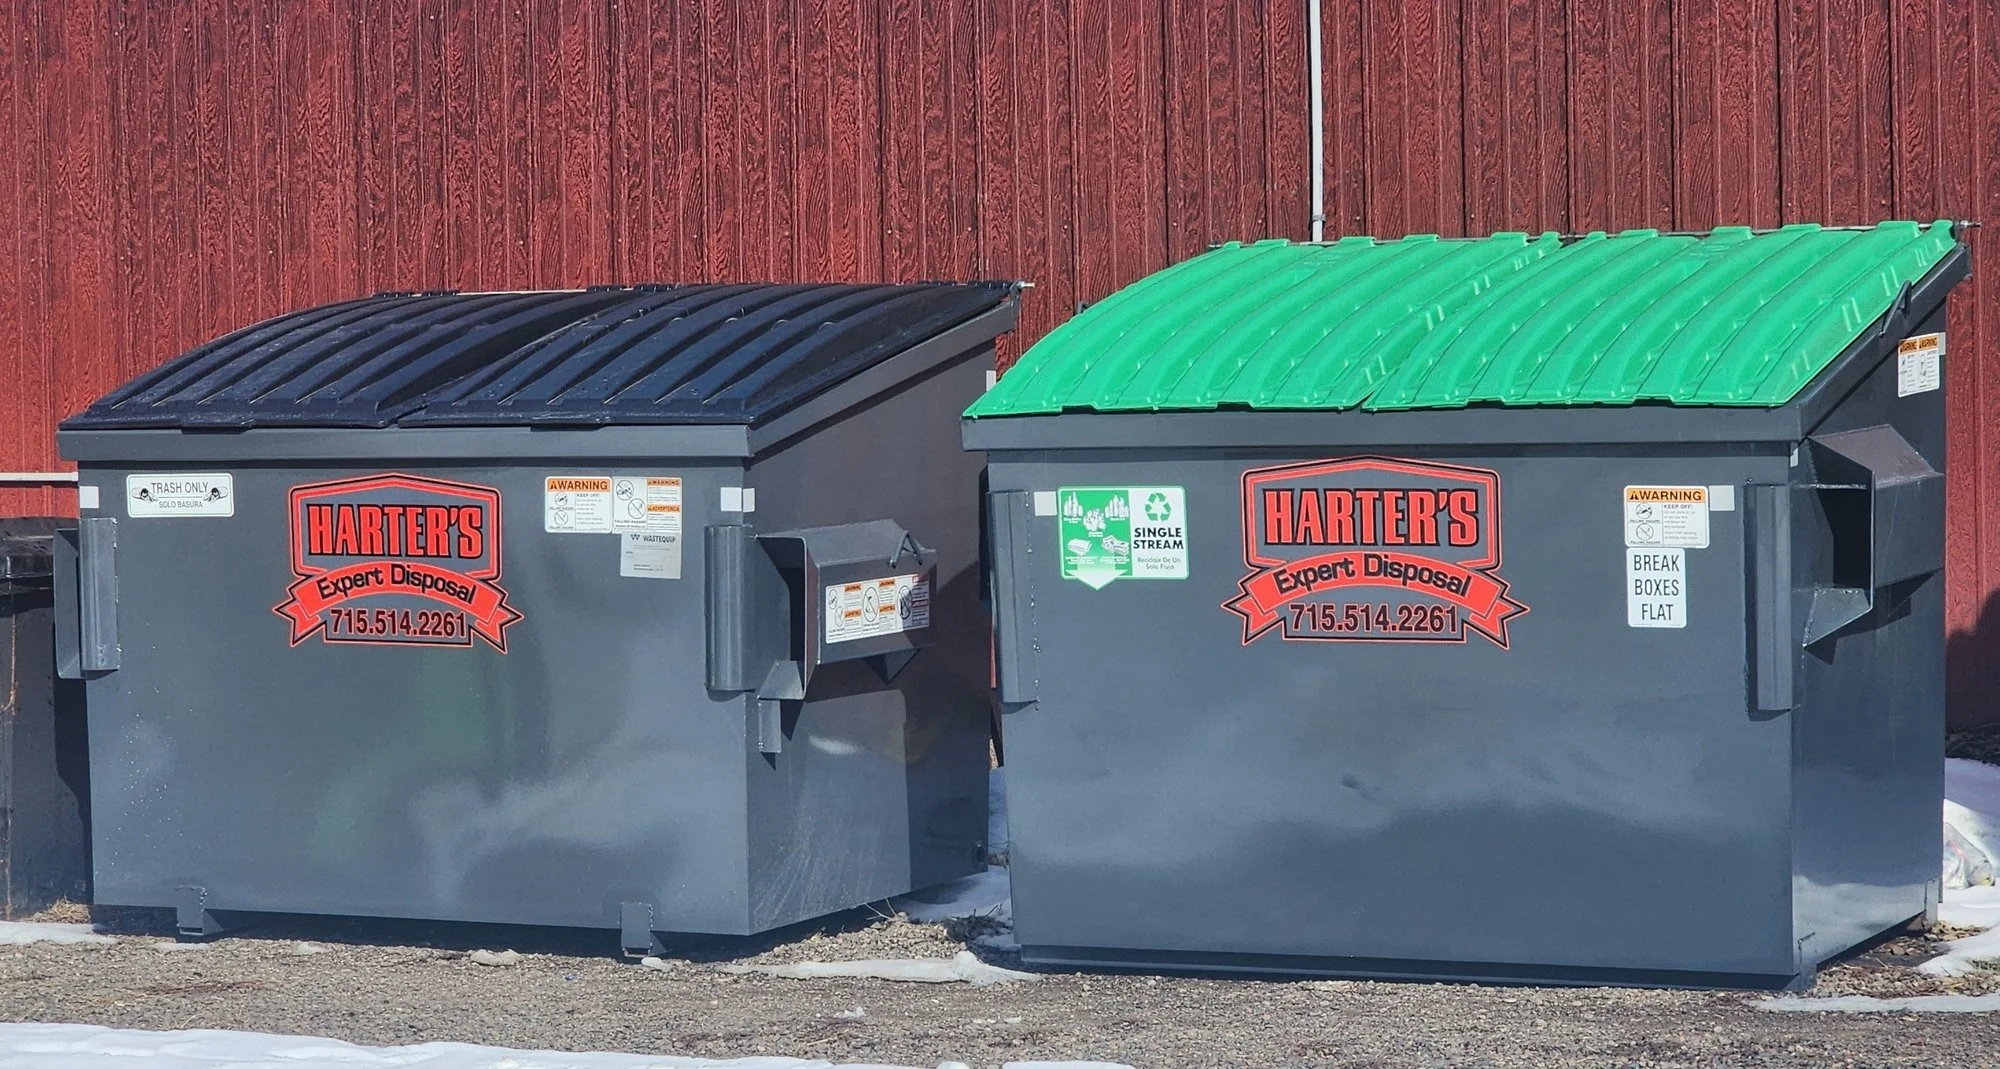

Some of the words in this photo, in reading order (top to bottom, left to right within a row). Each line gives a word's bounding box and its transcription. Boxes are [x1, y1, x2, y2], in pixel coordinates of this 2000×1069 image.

[151, 482, 182, 493] TRASH
[185, 482, 208, 493] ONLY
[558, 480, 608, 490] WARNING
[1640, 490, 1702, 501] WARNING
[1263, 488, 1478, 547] HARTER'S
[307, 504, 483, 559] HARTER'S
[643, 534, 676, 543] WASTEQUIP
[1134, 527, 1182, 538] SINGLE
[1133, 540, 1184, 550] STREAM
[1634, 555, 1680, 571] BREAK
[1273, 556, 1355, 595] Expert
[1364, 553, 1472, 597] Disposal
[317, 567, 384, 600] Expert
[391, 563, 477, 604] Disposal
[1635, 579, 1680, 596] BOXES
[1290, 604, 1458, 632] 715.514.2261
[1642, 604, 1674, 620] FLAT
[330, 609, 467, 637] 715.514.2261
